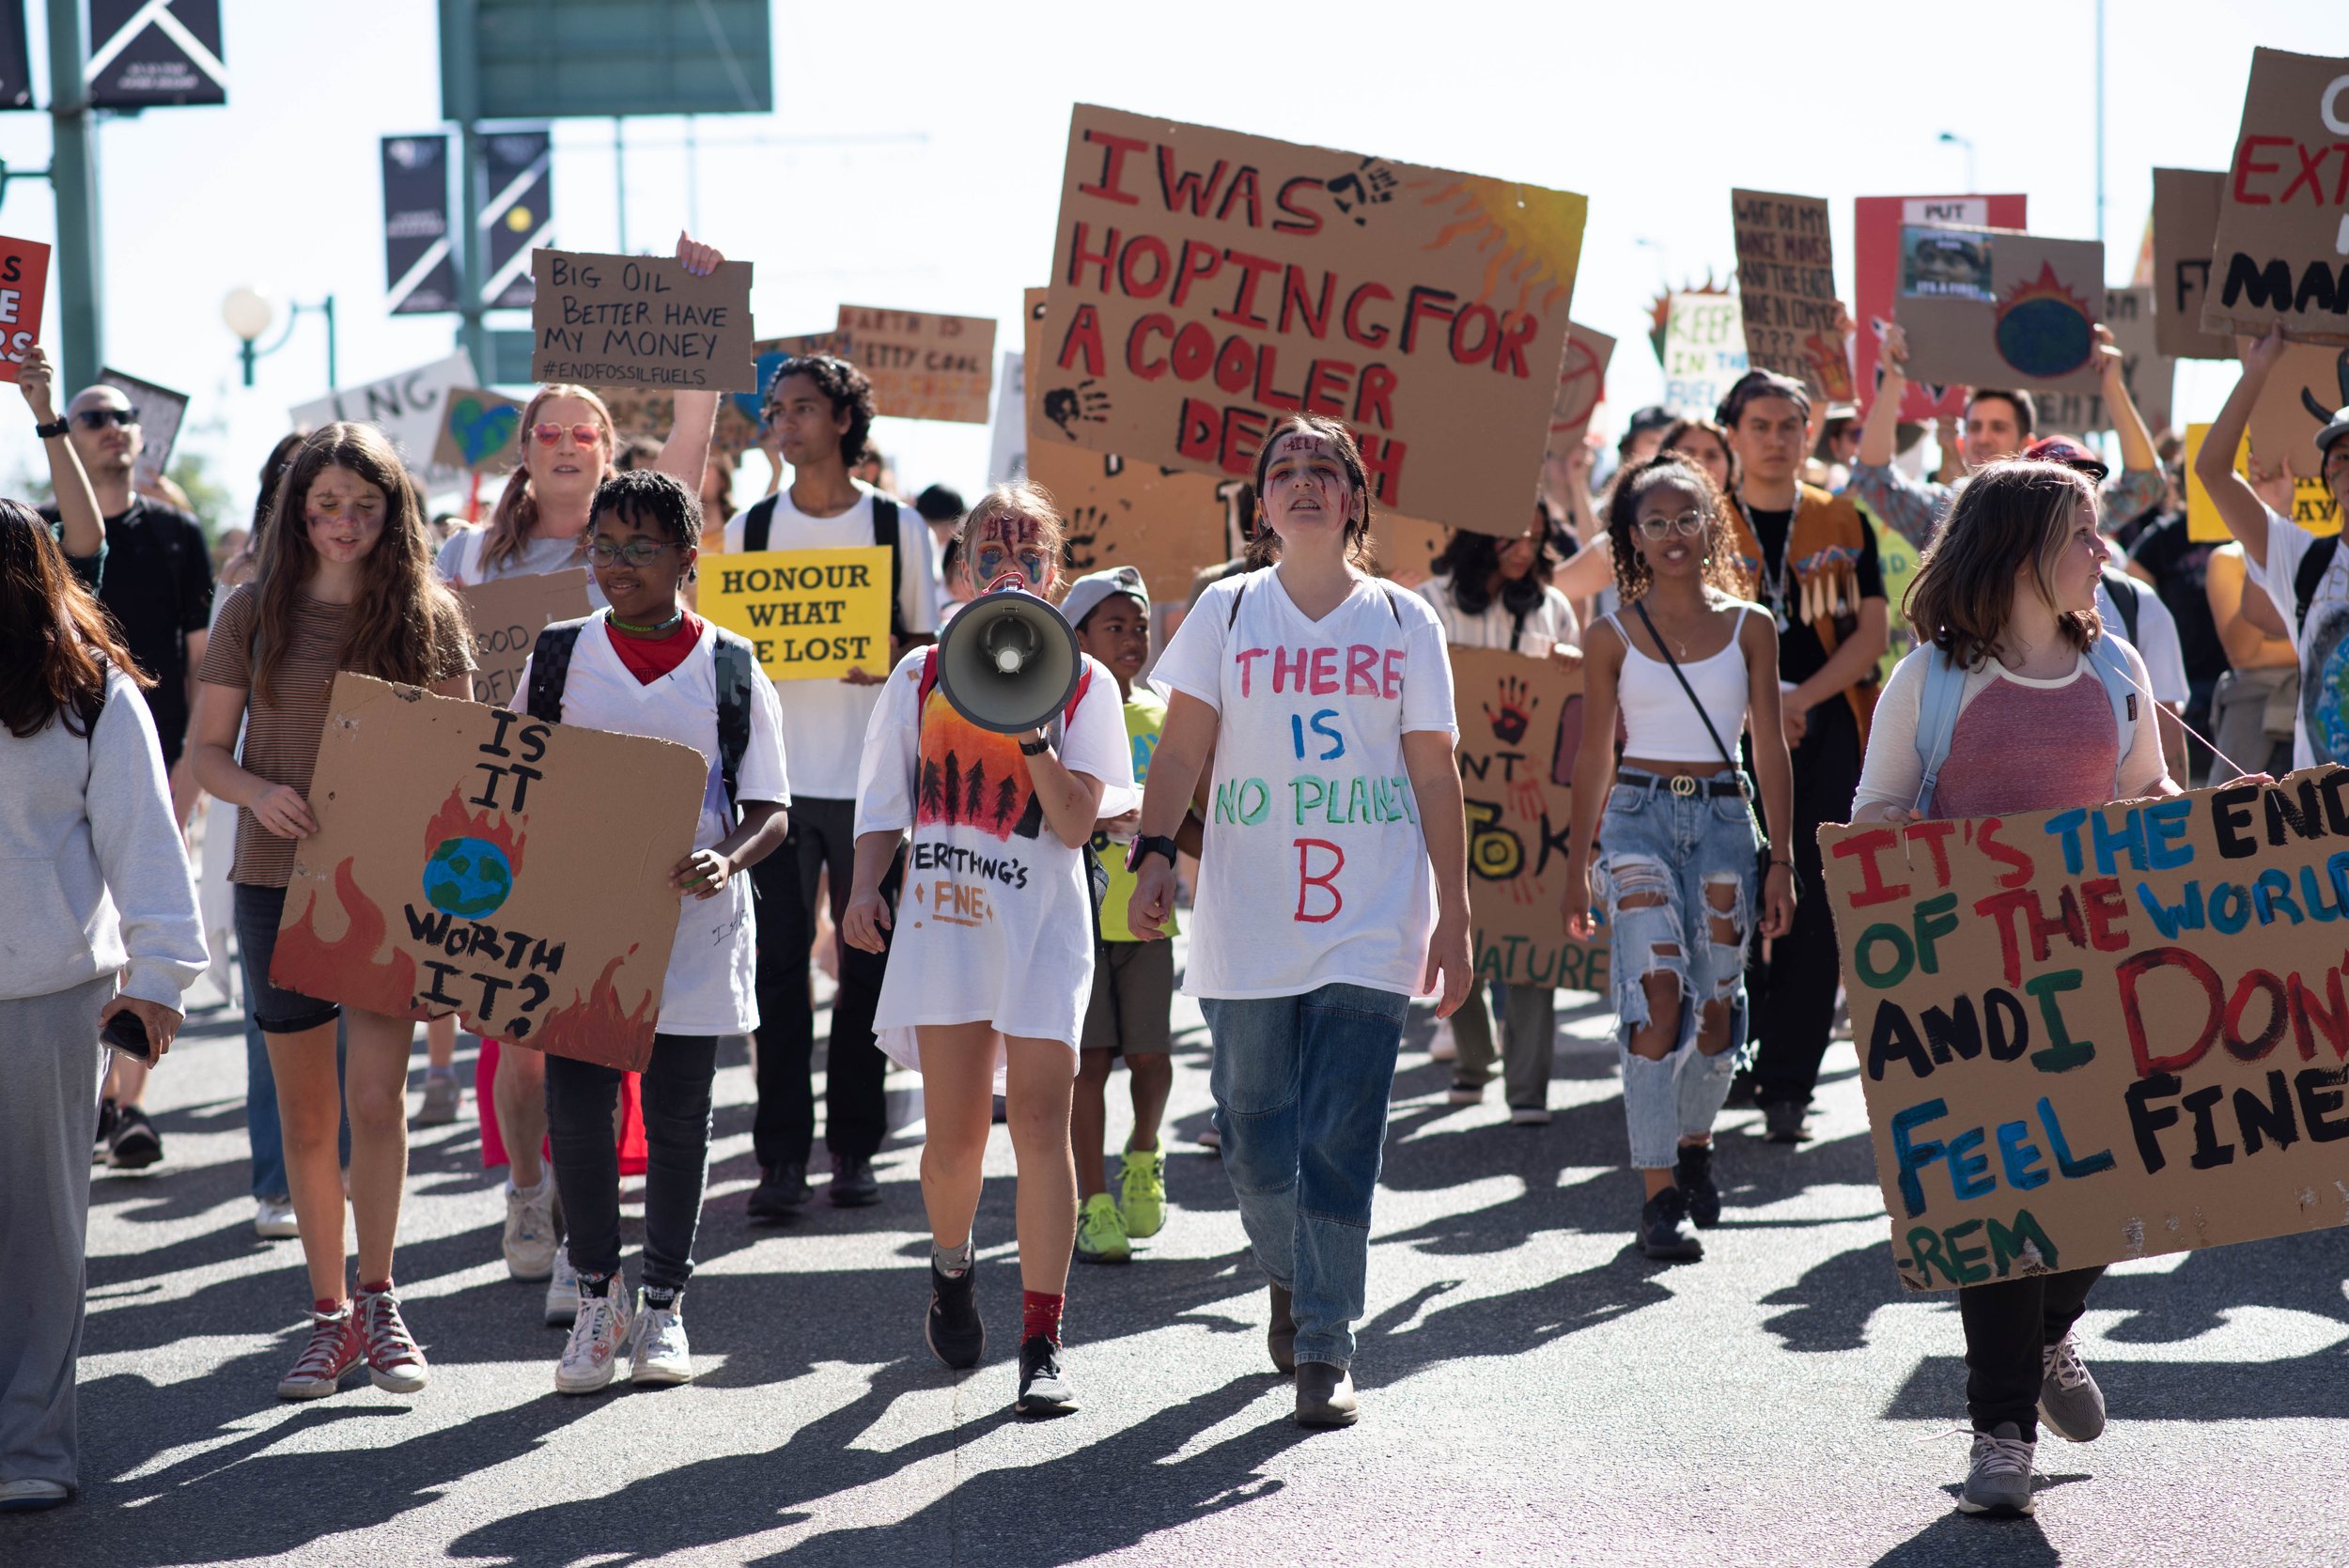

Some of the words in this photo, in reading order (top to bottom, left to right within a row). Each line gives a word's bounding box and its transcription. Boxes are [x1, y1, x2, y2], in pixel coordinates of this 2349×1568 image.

[1079, 128, 1149, 206] I
[1156, 143, 1326, 237] WAS
[1924, 203, 1965, 220] PUT
[552, 257, 601, 288] BIG
[623, 262, 671, 293] OIL
[1067, 221, 1396, 349] HOPING
[1399, 285, 1540, 380] FOR
[562, 296, 653, 325] BETTER
[665, 303, 727, 327] HAVE
[1672, 304, 1735, 344] KEEP
[543, 327, 583, 354] MY
[602, 329, 718, 361] MONEY
[1057, 303, 1107, 378] A
[1126, 312, 1400, 430] COOLER
[1674, 351, 1705, 375] IN
[543, 361, 707, 385] #ENDFOSSILFUELS
[1176, 397, 1408, 508] DEH
[1283, 436, 1324, 452] HELP
[985, 517, 1039, 544] HELP
[721, 565, 871, 594] HONOUR
[746, 600, 846, 627] WHAT
[784, 636, 871, 662] LOST
[1236, 644, 1407, 701] THERE
[479, 710, 552, 763] IS
[1291, 709, 1346, 761] IS
[470, 762, 543, 814] IT
[1214, 777, 1271, 827] NO
[1832, 817, 2036, 909] IT'S
[2045, 799, 2196, 876] THE
[1293, 838, 1346, 924] B
[405, 904, 567, 974] WORTH
[1855, 893, 1959, 989] OF
[1974, 877, 2130, 988] THE
[415, 960, 551, 1038] IT?
[1868, 987, 2029, 1082] AND
[2026, 969, 2096, 1073] I
[1890, 1096, 2117, 1219] FEEL
[2124, 1063, 2349, 1175] FINE
